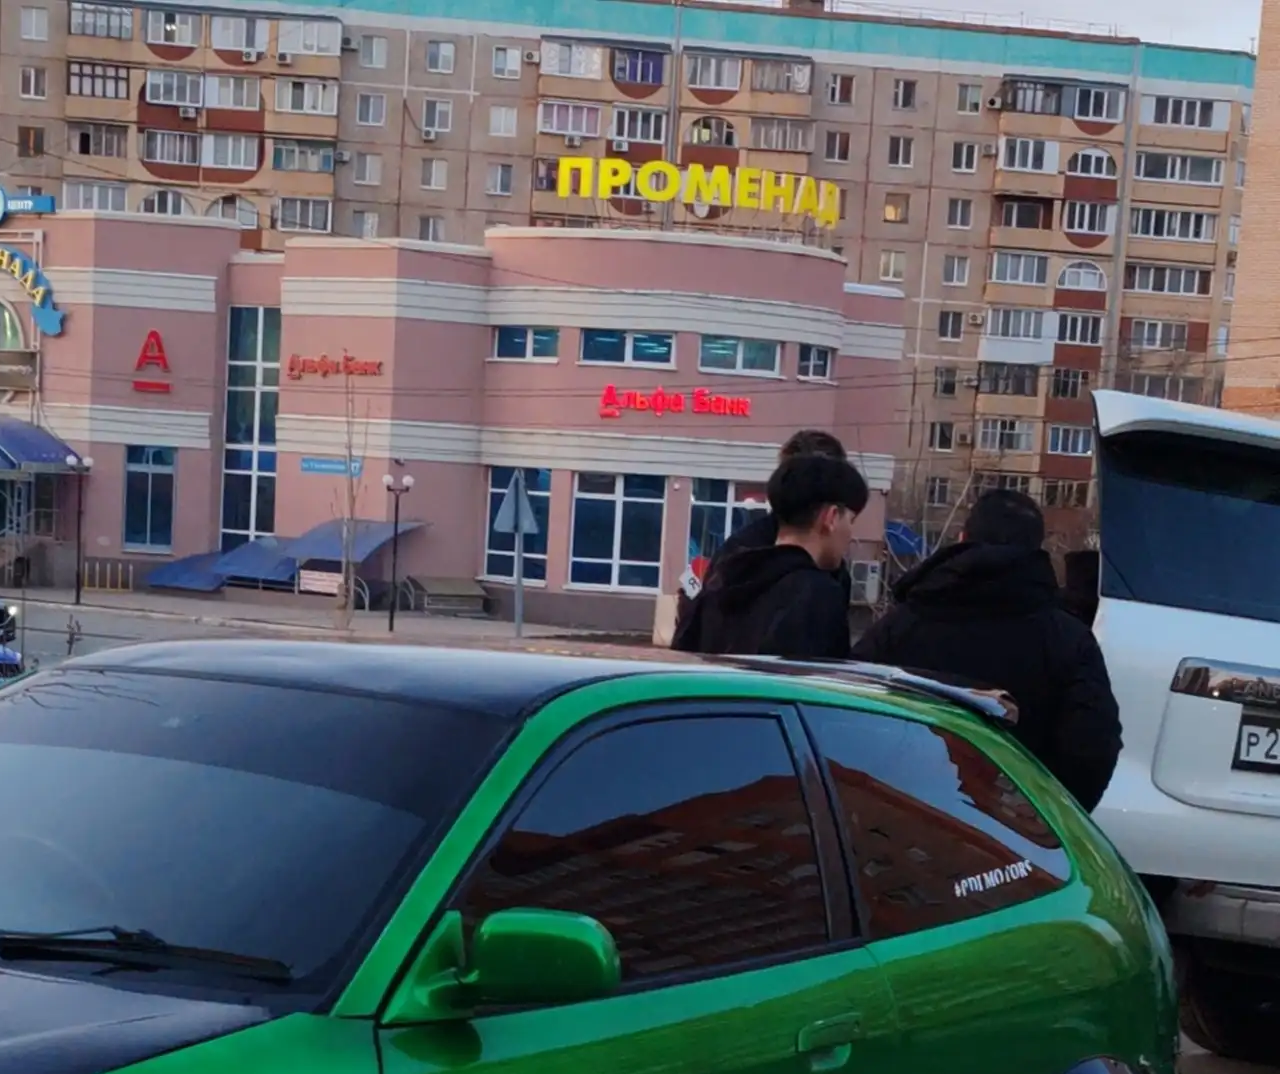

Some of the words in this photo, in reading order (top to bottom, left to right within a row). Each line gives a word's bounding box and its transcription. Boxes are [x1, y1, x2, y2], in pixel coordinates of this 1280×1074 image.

[557, 156, 839, 230] ПРОМЕНАД
[600, 384, 686, 418] Альфа
[693, 387, 752, 417] Банк
